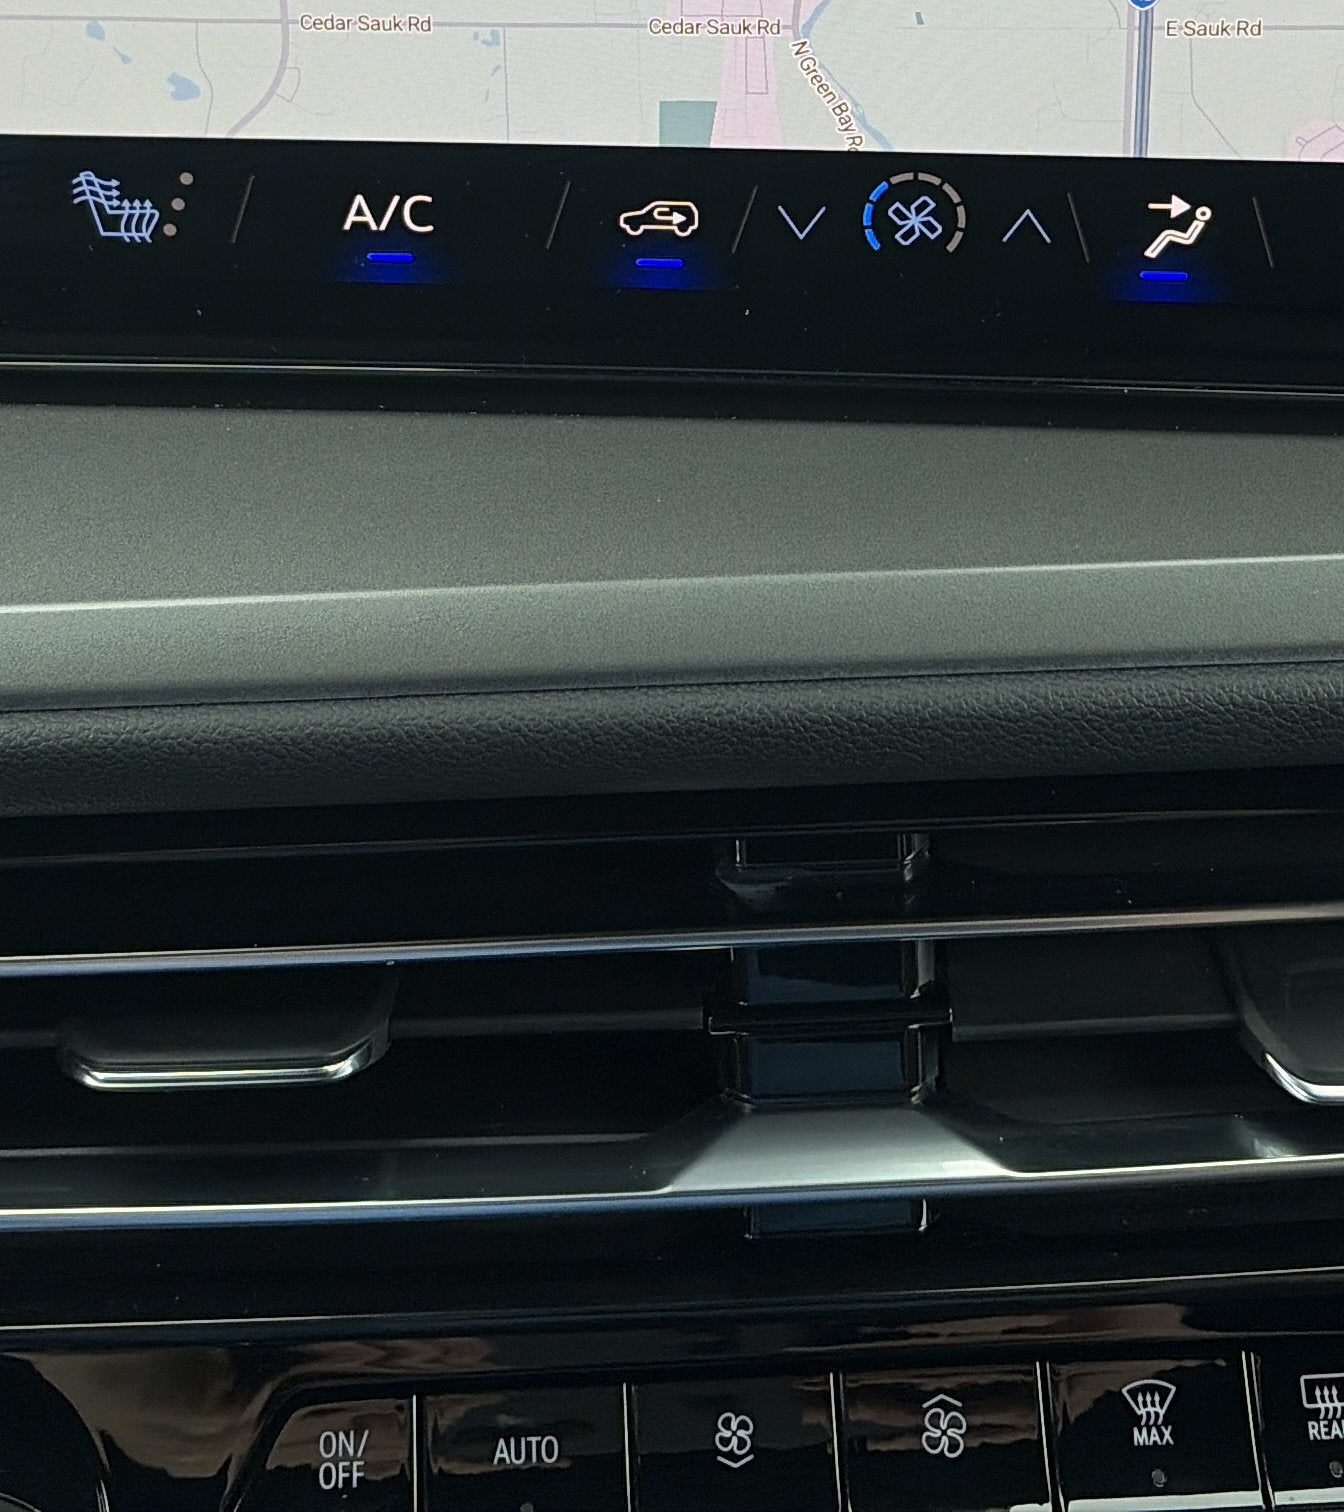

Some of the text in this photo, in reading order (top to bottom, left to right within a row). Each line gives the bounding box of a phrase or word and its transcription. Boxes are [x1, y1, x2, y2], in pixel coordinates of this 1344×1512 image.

[299, 14, 432, 33] Cedar Sauk Rd
[648, 18, 781, 36] Cedar Sauk Rd
[1166, 20, 1262, 37] E Sauk Rd
[791, 40, 811, 56] N
[800, 56, 837, 105] Green
[832, 101, 856, 132] Bay
[342, 194, 435, 233] A/C
[319, 1430, 370, 1459] ON/
[493, 1435, 560, 1465] AUTO
[1133, 1425, 1175, 1446] MAX
[319, 1461, 365, 1490] OFF
